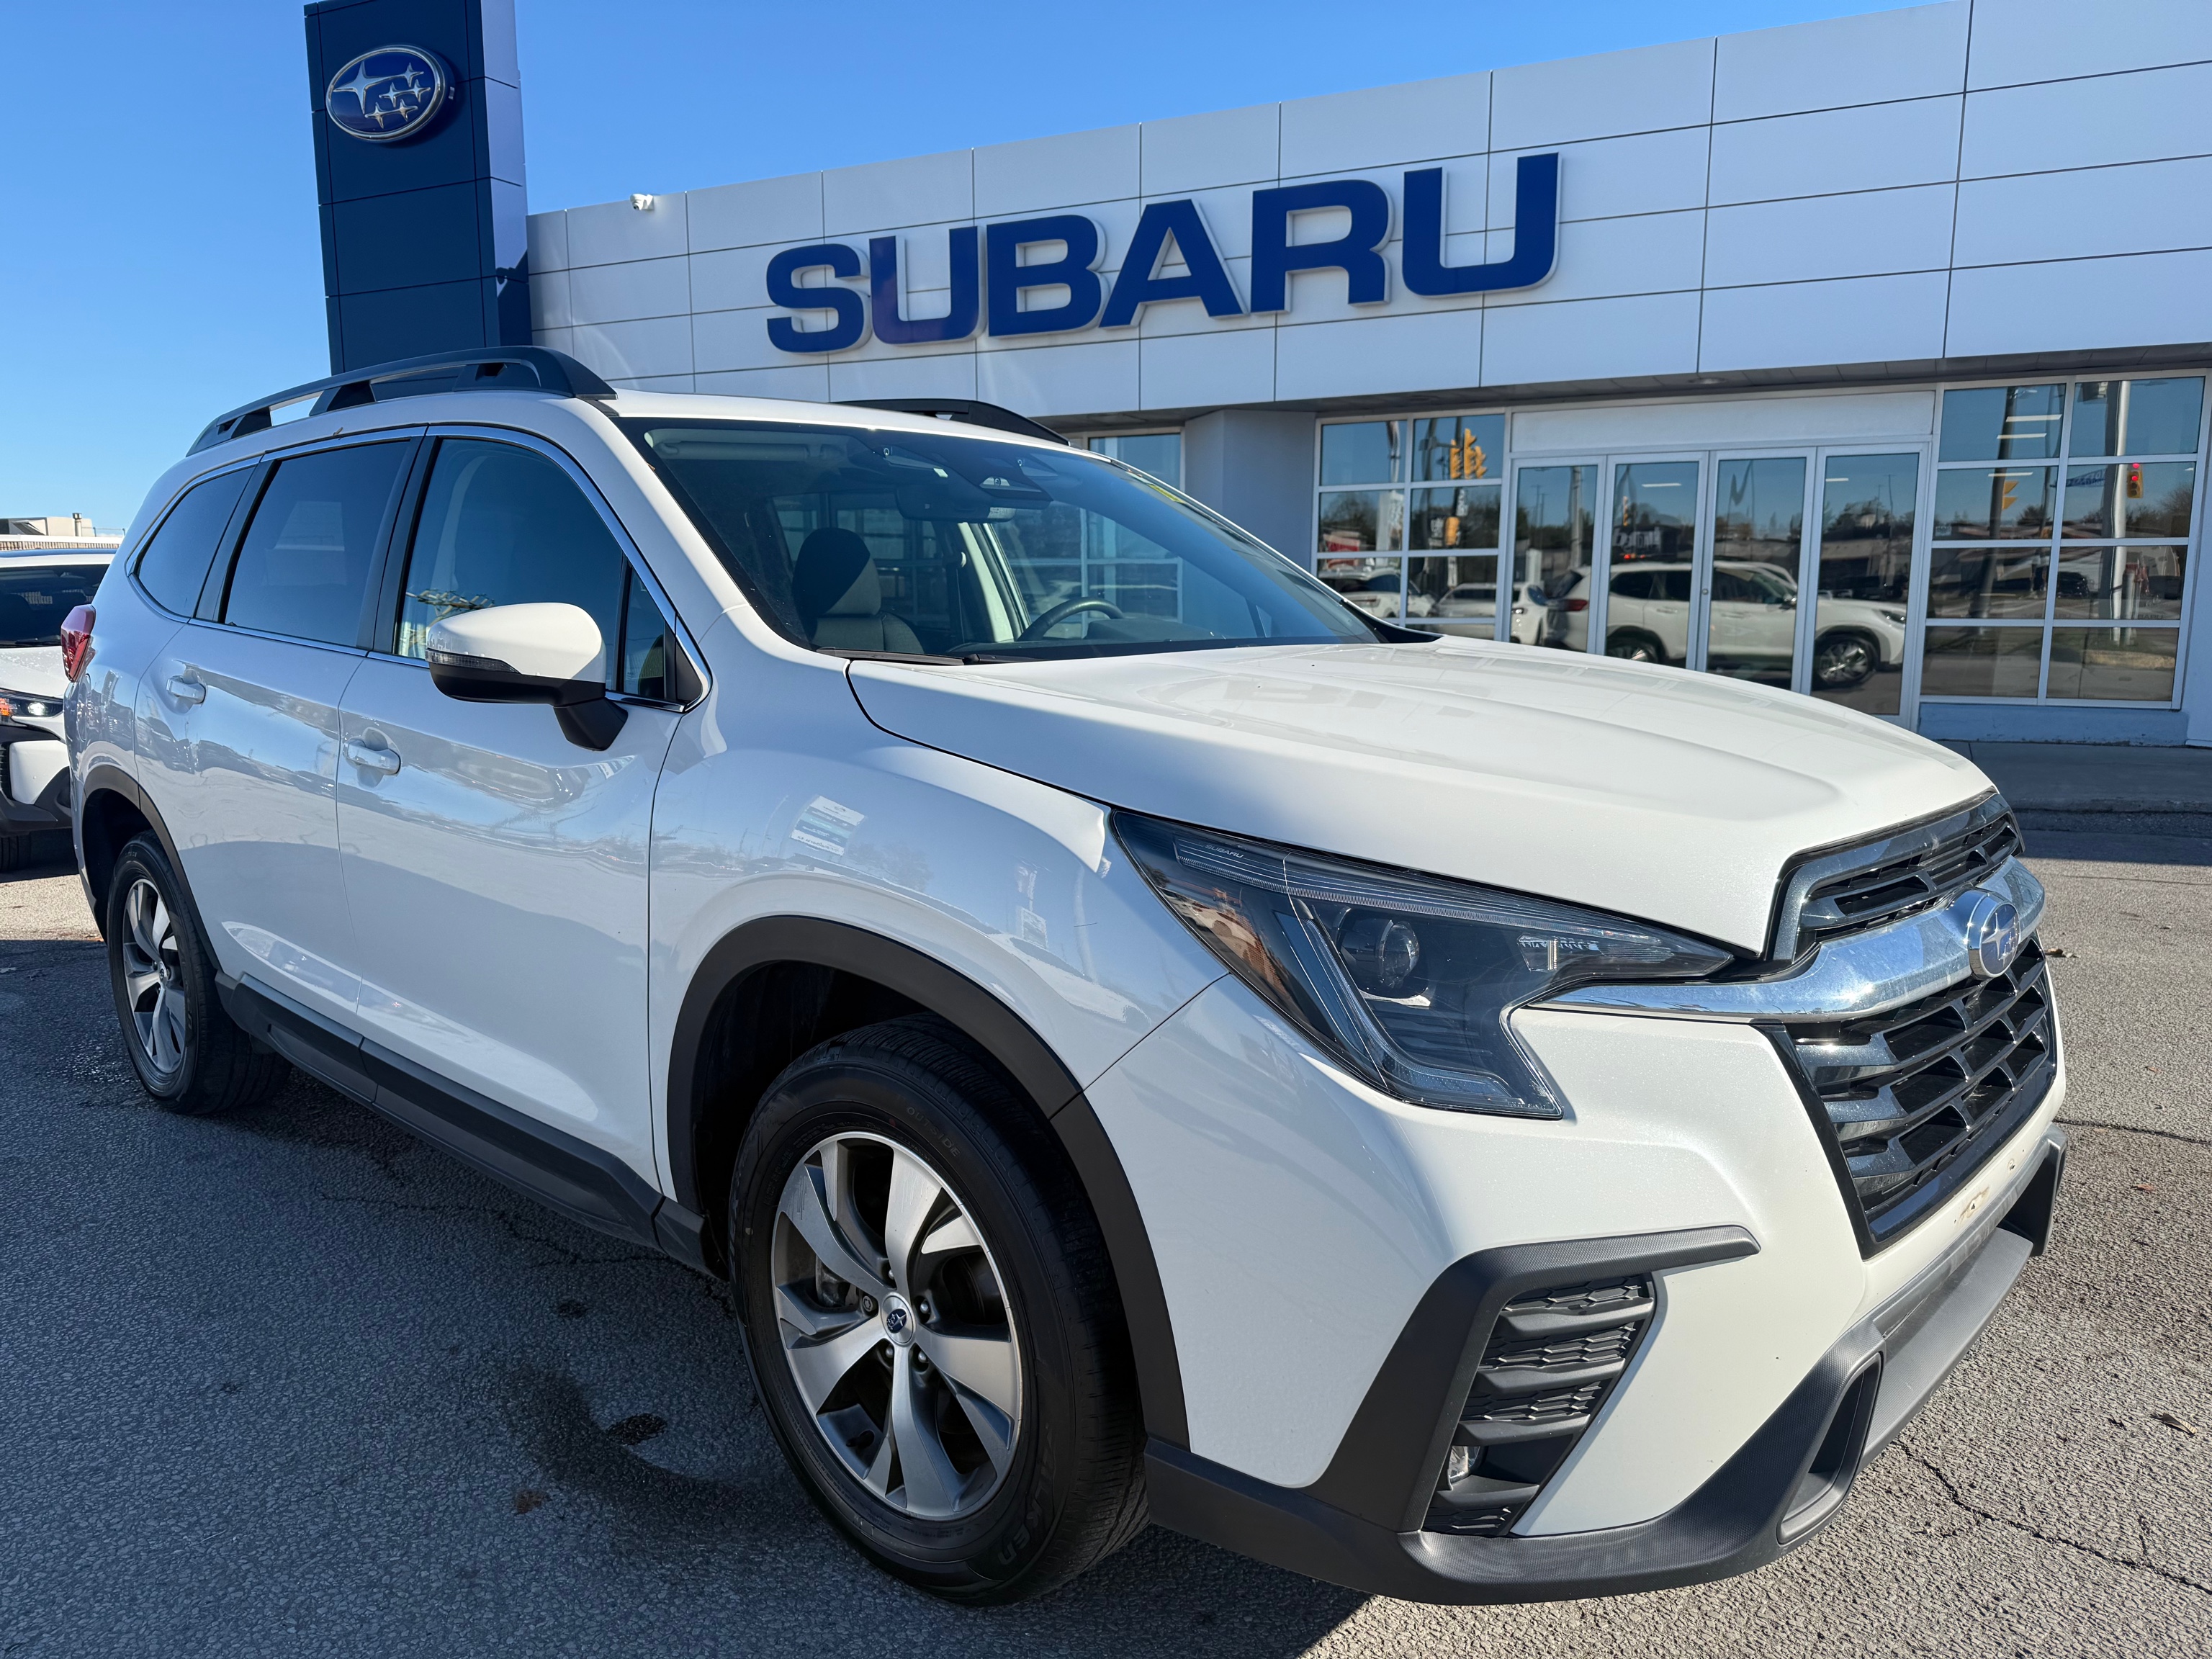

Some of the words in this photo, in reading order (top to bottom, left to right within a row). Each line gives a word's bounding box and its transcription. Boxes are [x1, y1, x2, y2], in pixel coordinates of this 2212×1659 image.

[766, 152, 1561, 354] SUBARU
[1205, 845, 1244, 858] SUBARU
[907, 1107, 961, 1157] OUTSIDE
